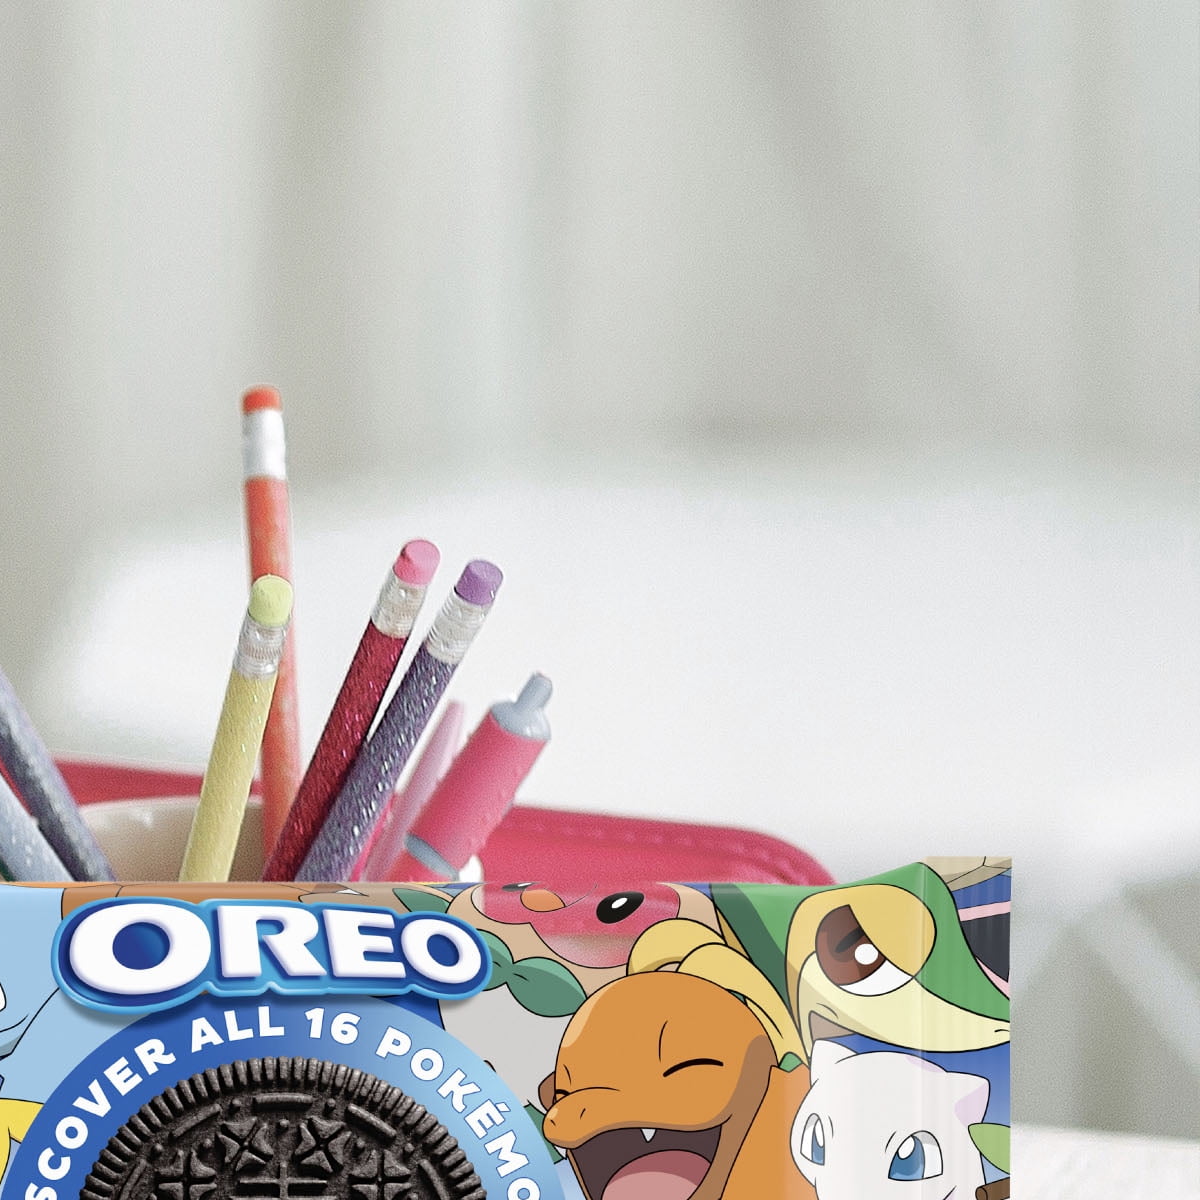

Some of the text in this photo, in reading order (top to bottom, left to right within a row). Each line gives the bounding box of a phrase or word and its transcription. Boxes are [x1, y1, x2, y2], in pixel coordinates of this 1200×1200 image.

[69, 902, 482, 995] OREO
[189, 1005, 286, 1053] ALL
[304, 1006, 361, 1046] 16
